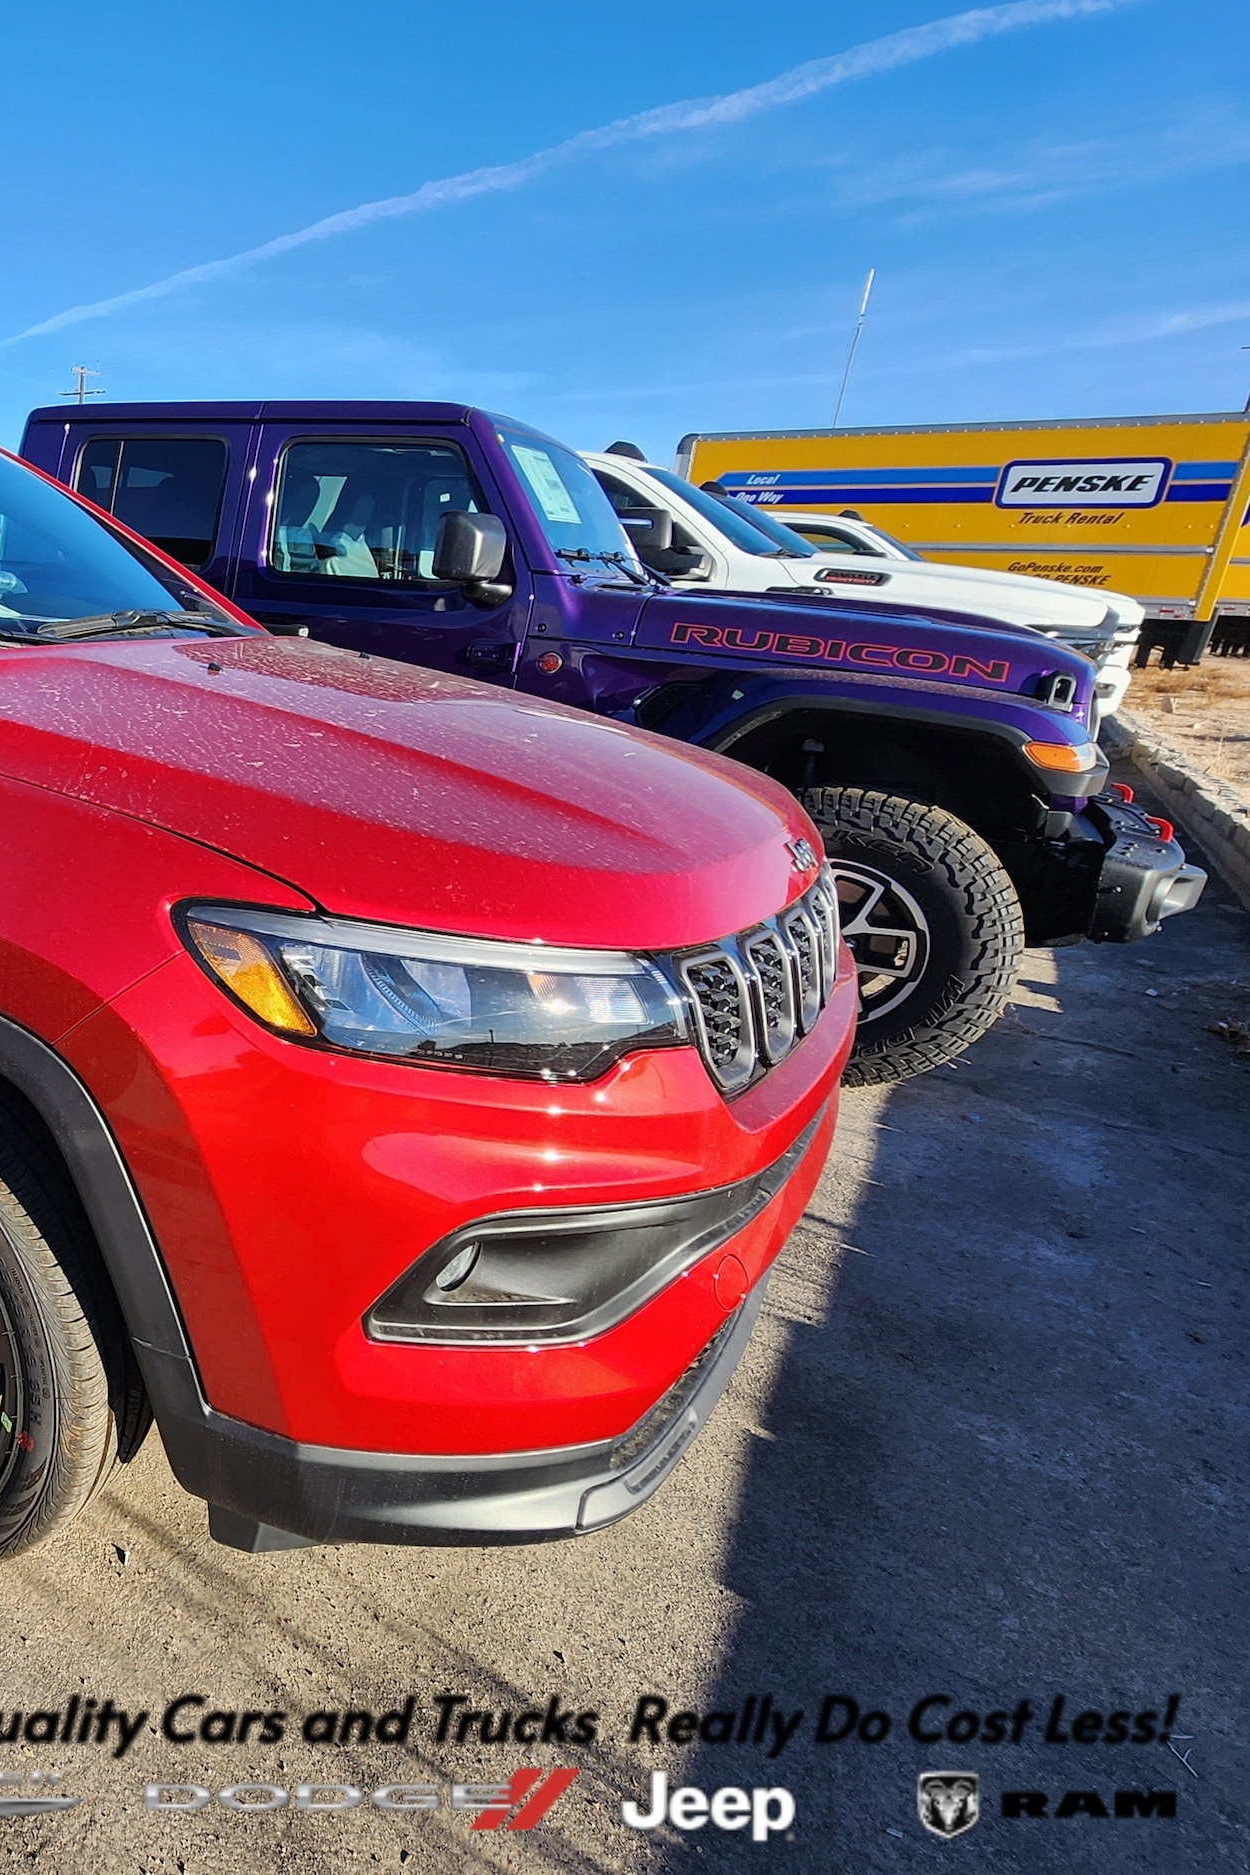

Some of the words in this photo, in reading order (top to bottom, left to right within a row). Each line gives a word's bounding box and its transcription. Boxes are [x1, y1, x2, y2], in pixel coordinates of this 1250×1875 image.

[746, 473, 781, 485] Local
[1009, 474, 1155, 493] PENSKE
[757, 491, 785, 504] Way
[1018, 512, 1064, 525] Truck
[1064, 512, 1125, 525] Rental
[1007, 561, 1104, 574] GoPenske.com
[670, 622, 1011, 683] RUBICON
